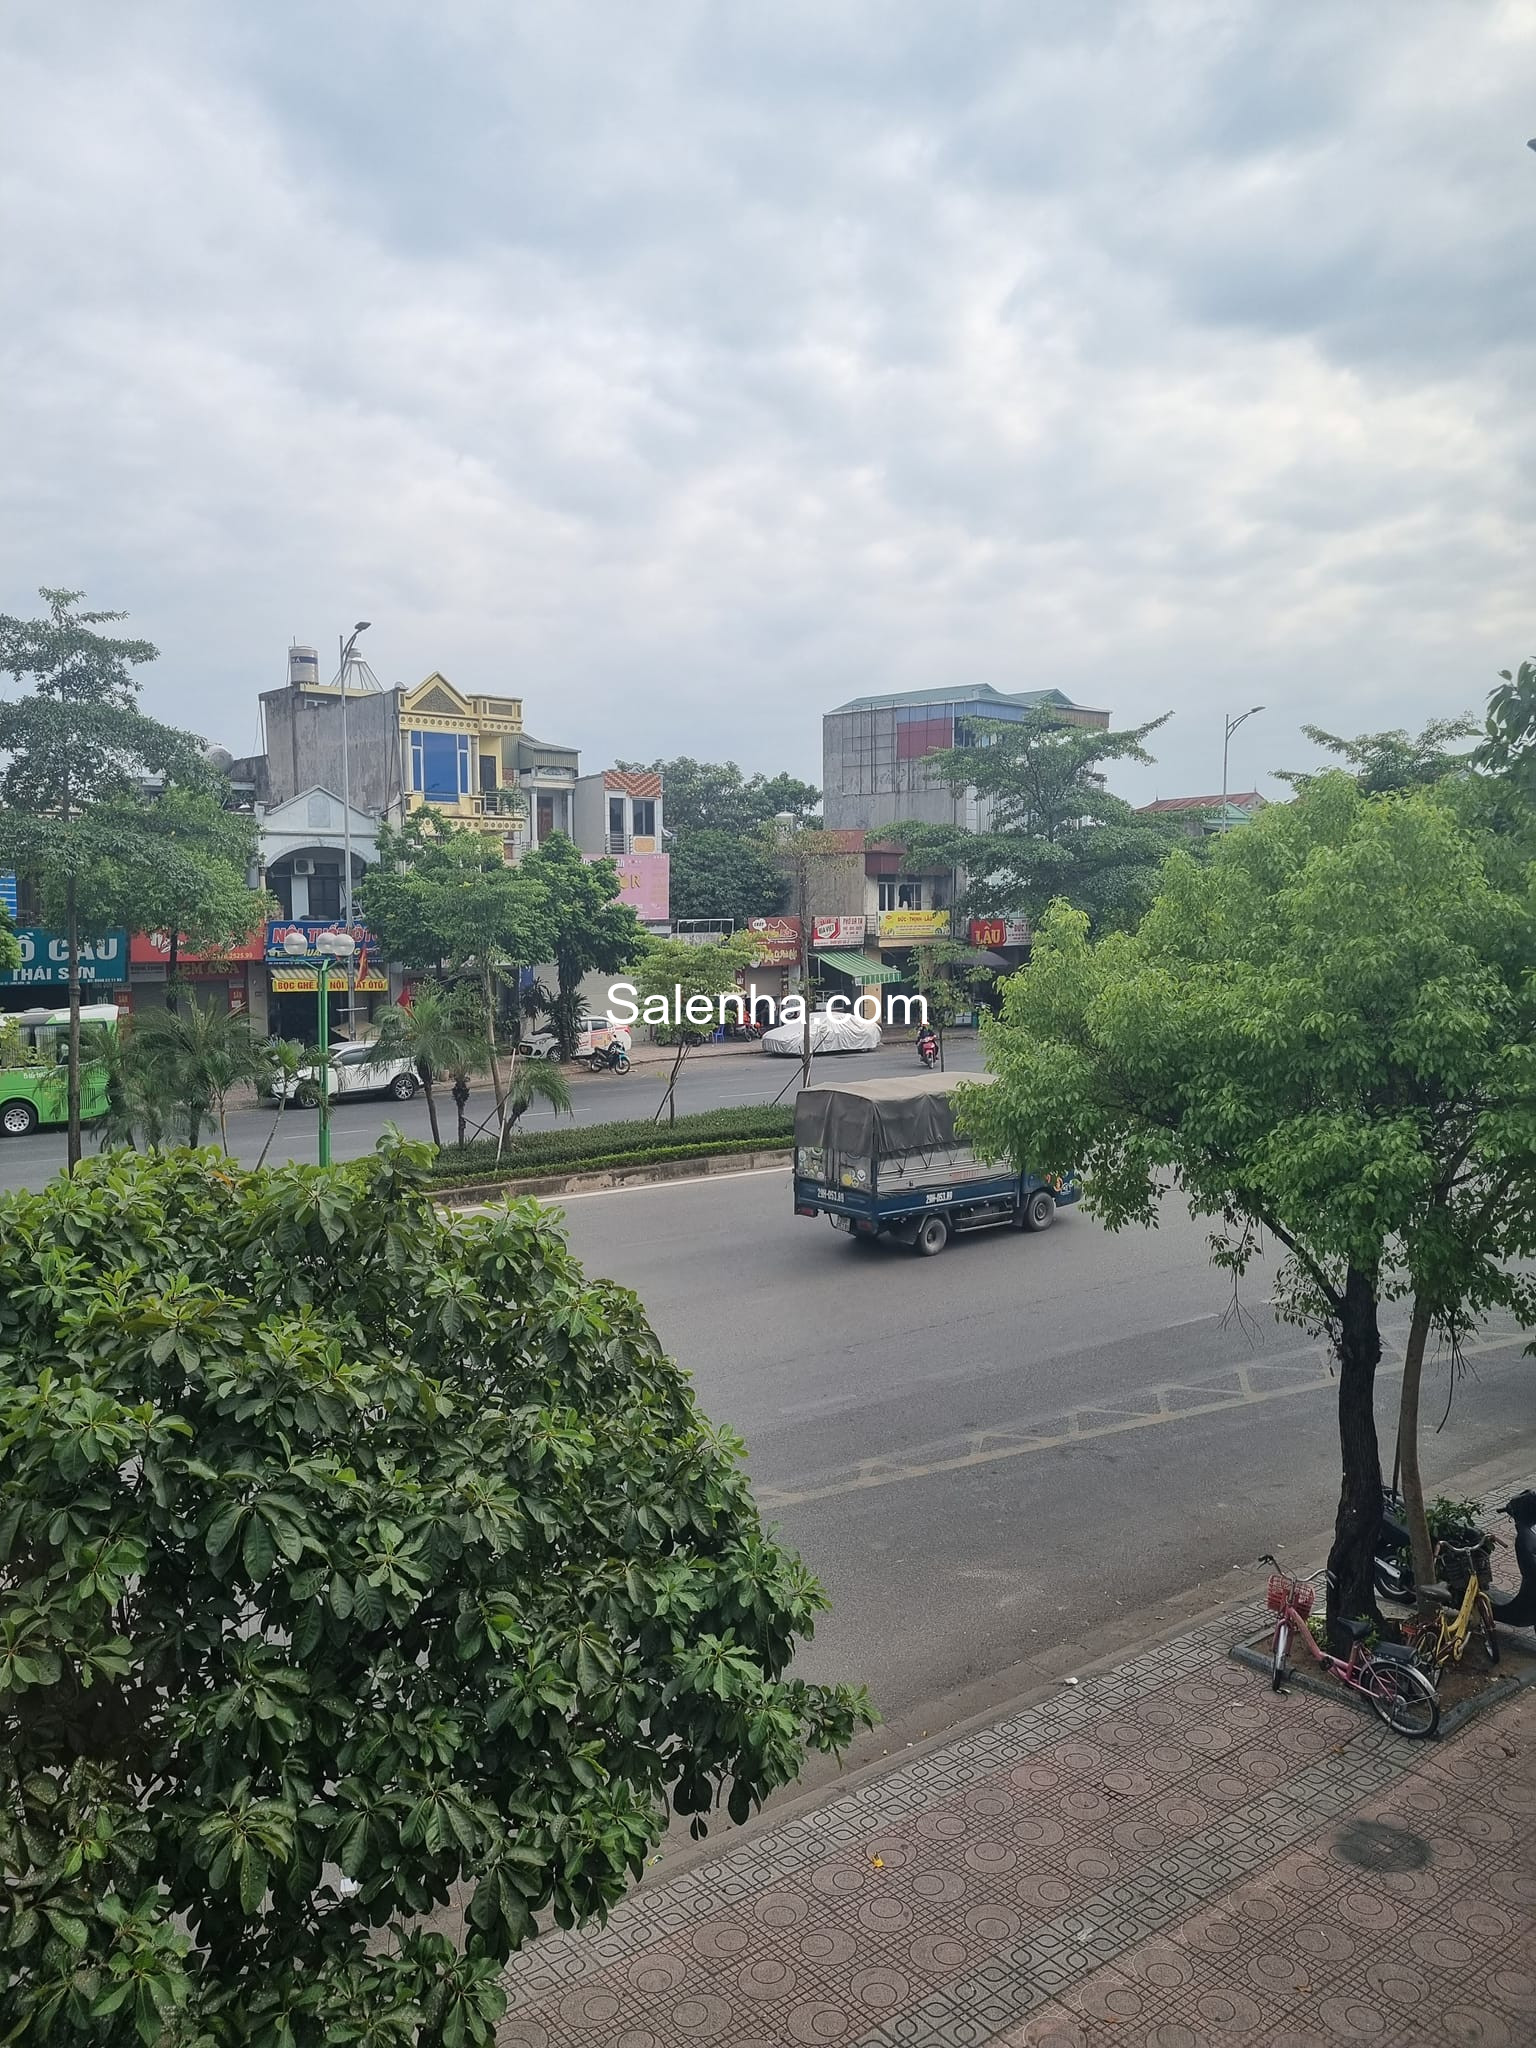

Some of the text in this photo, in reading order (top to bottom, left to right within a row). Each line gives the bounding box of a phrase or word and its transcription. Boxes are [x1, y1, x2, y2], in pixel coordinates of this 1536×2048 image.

[17, 931, 34, 962] Ồ
[13, 966, 52, 981] THÁI
[277, 981, 295, 991] BỌC
[330, 980, 344, 990] NỘI
